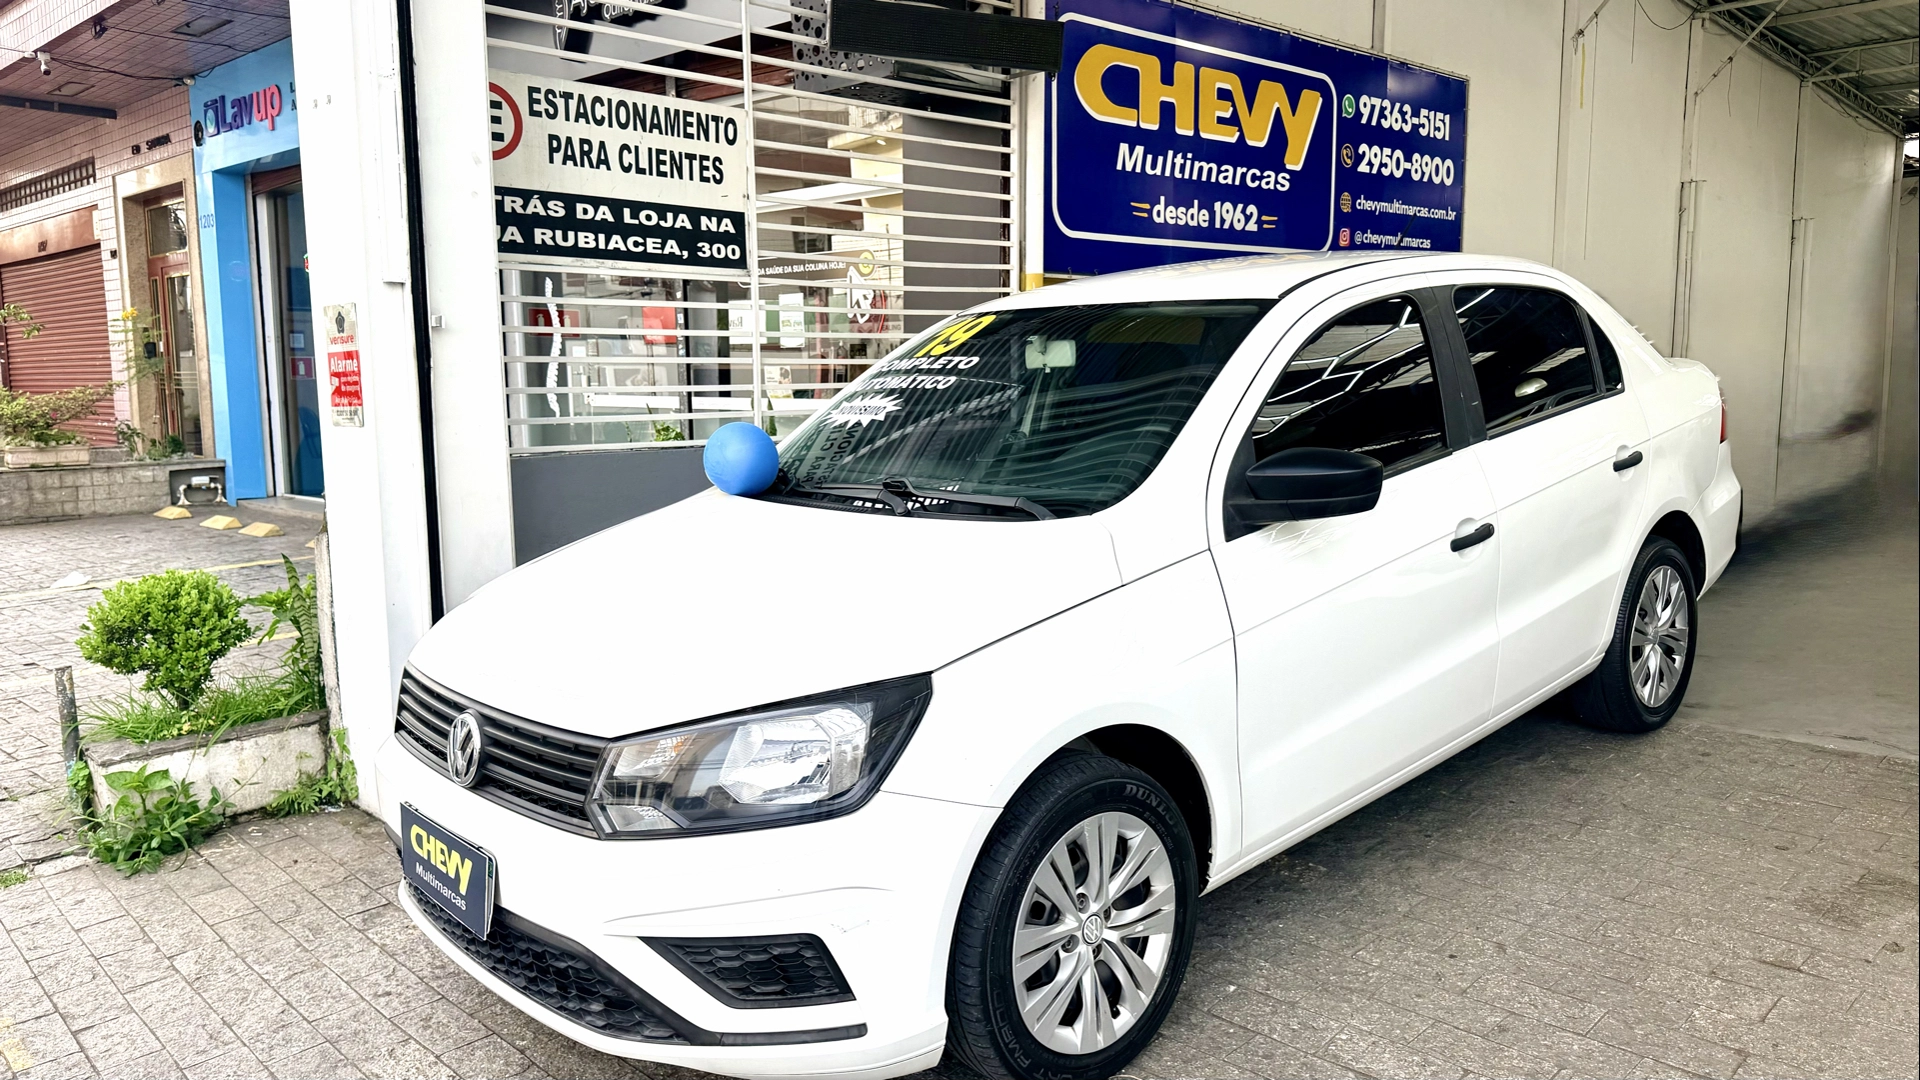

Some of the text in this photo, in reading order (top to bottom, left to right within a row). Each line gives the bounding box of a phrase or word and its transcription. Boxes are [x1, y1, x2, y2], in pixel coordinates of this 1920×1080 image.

[218, 84, 282, 132] Lavup
[527, 86, 738, 146] ESTACIONAMENTO
[1074, 43, 1322, 171] CHEVY
[1359, 94, 1450, 141] 97363-5151
[547, 133, 724, 185] PARA CLIENTES
[1116, 142, 1291, 192] Multimarcas
[1357, 143, 1454, 186] 2950-8900
[575, 203, 615, 222] DA
[623, 207, 693, 230] LOJA
[700, 215, 736, 234] NA
[1152, 195, 1258, 232] desde 1962
[1356, 195, 1457, 220] chevymultimarcas.com.br
[533, 228, 689, 260] RUBIACEA,
[696, 242, 741, 260] 300
[330, 335, 354, 345] verisure
[913, 314, 997, 357] 19
[330, 356, 358, 373] Alarme
[410, 824, 473, 896] CHEVY
[415, 862, 467, 911] Multimarcas
